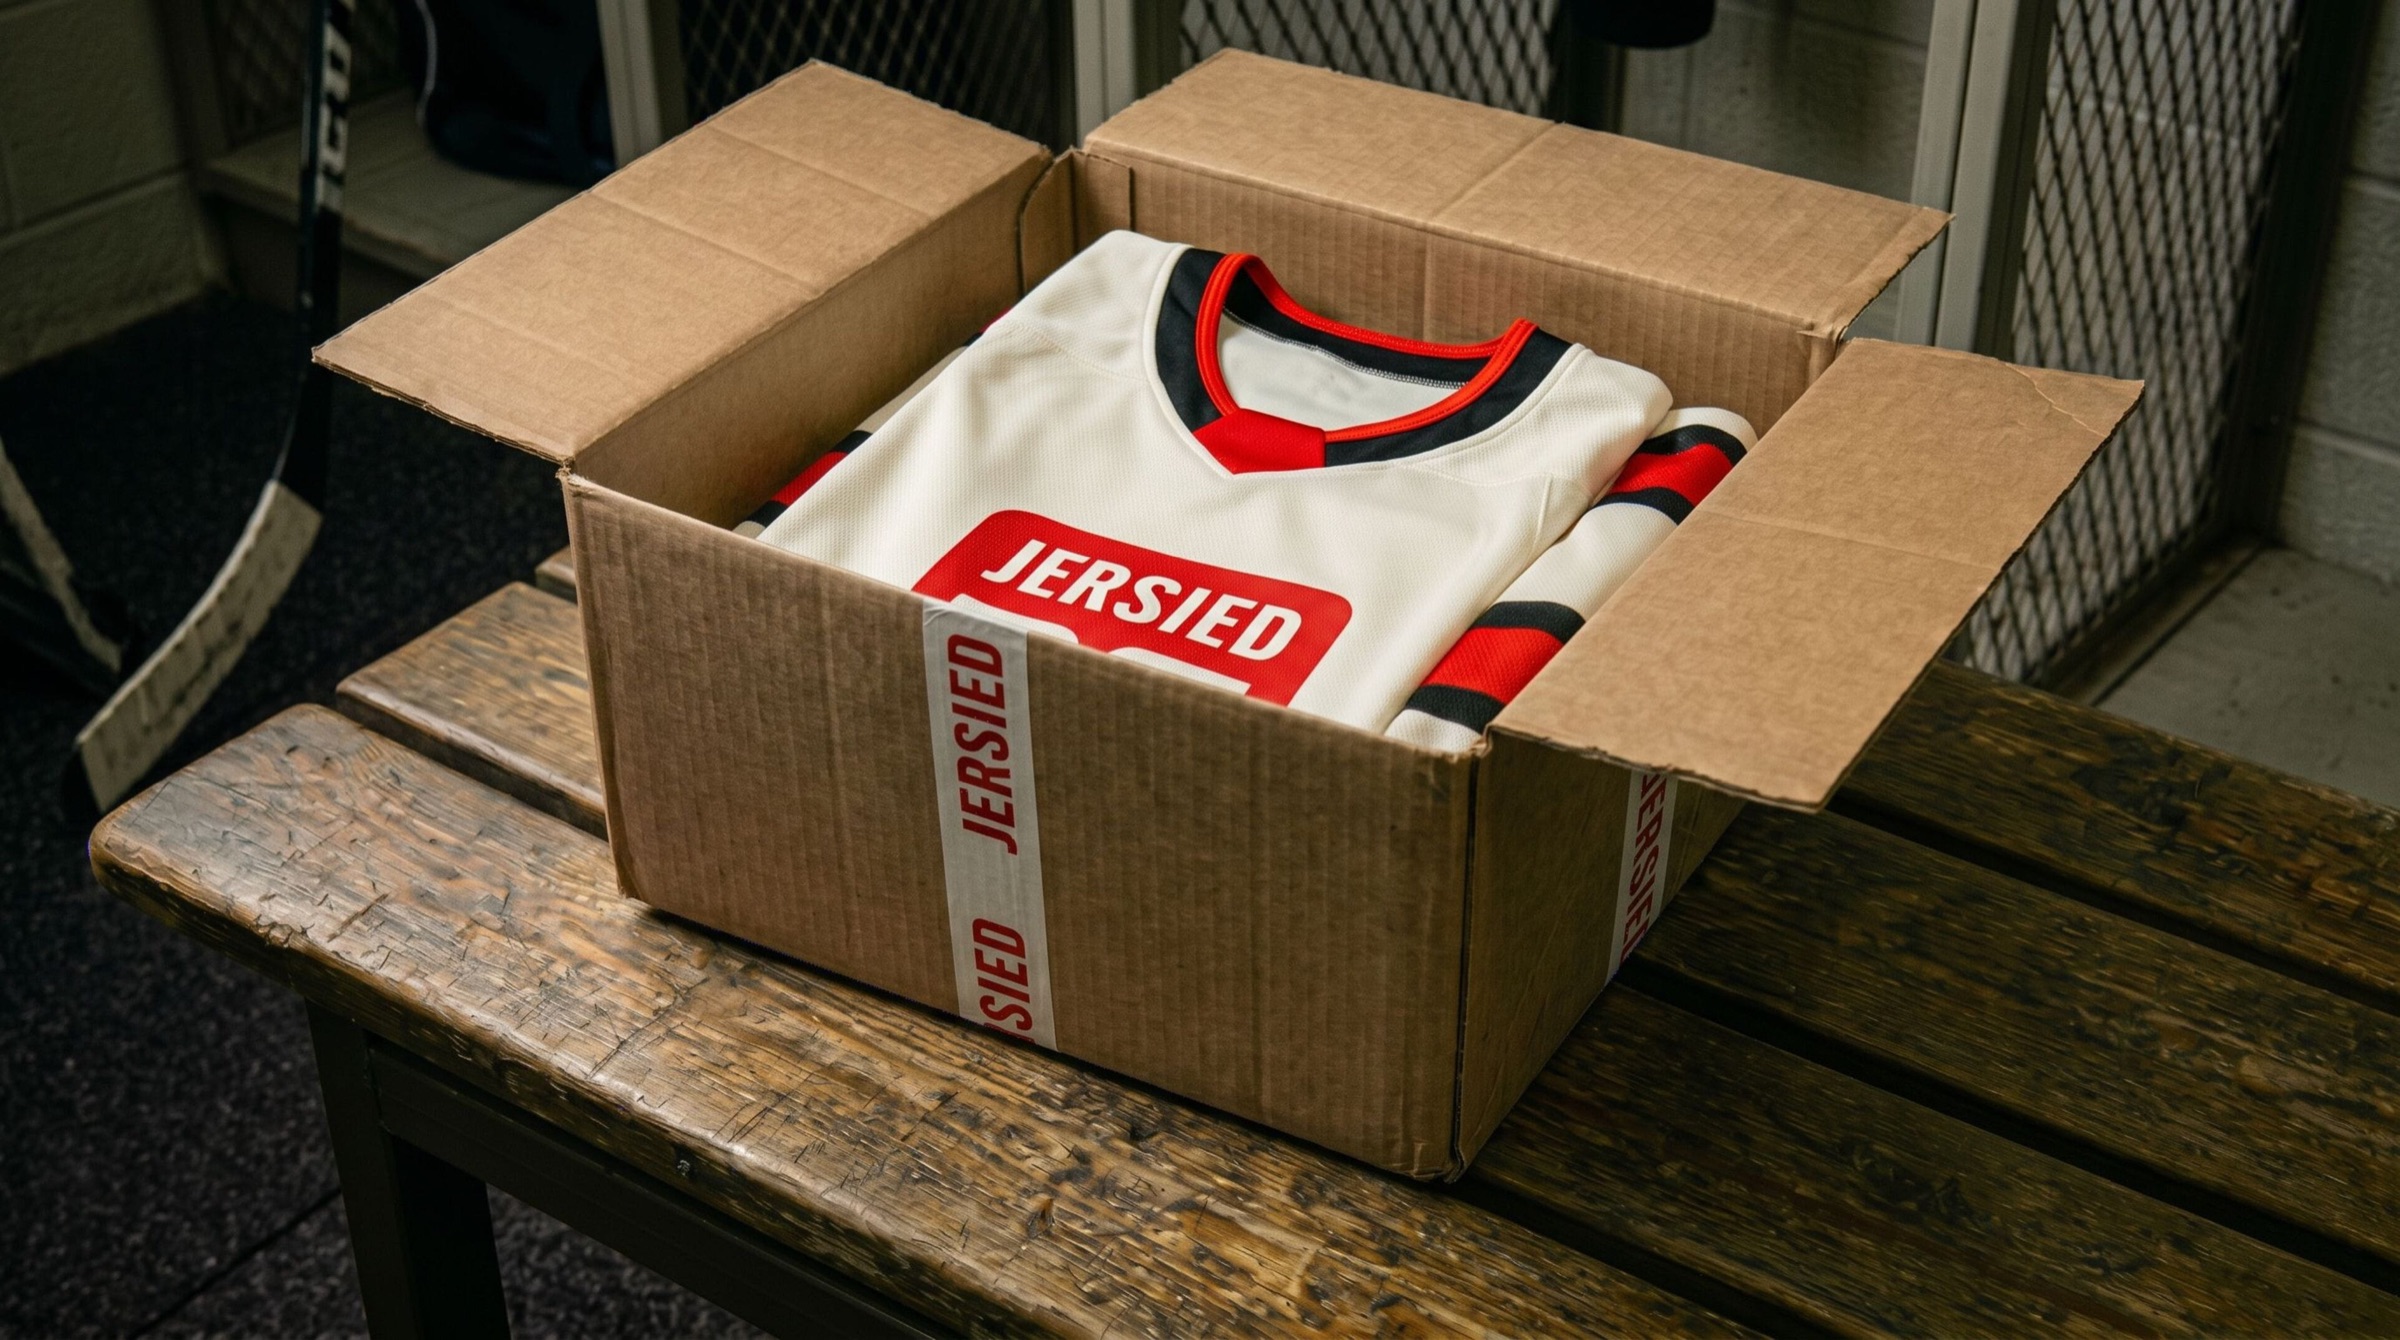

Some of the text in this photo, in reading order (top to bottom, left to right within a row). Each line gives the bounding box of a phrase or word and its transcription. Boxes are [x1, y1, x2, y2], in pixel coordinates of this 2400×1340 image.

[980, 538, 1302, 661] JERSIED
[947, 634, 1018, 855] JERSIED
[972, 918, 1035, 1044] SIED
